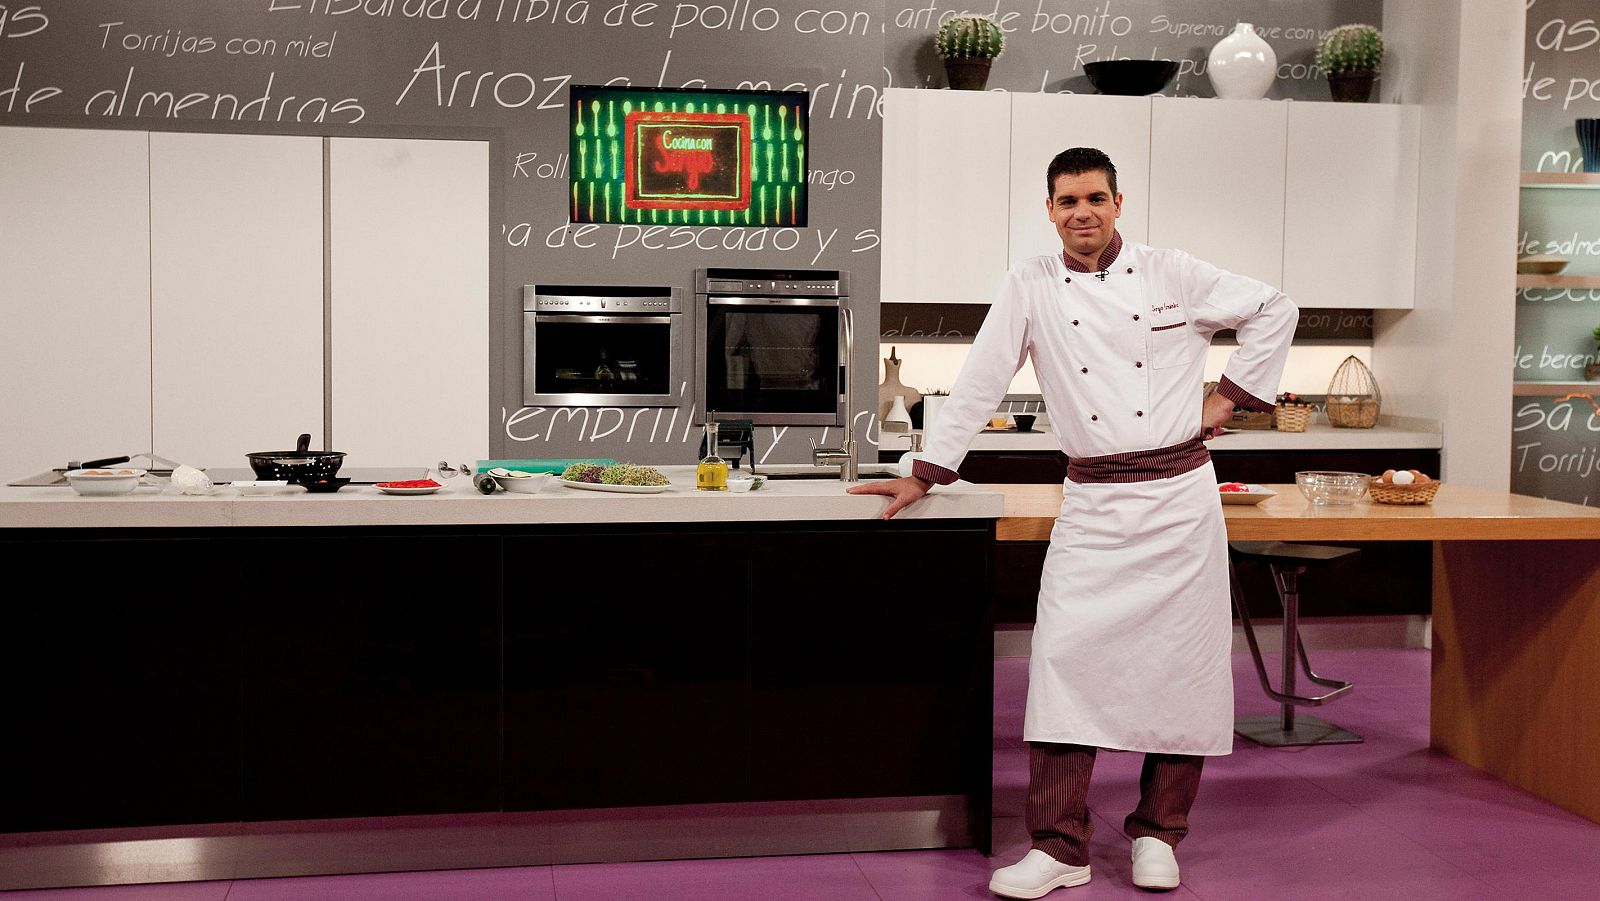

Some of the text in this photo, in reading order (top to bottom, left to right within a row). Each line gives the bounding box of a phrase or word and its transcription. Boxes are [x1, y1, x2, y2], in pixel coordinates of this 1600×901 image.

[0, 5, 49, 38] s
[267, 0, 483, 21] nsaada
[604, 0, 658, 27] de
[669, 0, 780, 39] pollo
[794, 10, 870, 35] con
[1031, 0, 1132, 37] bonito
[1149, 15, 1225, 39] Suprema
[1284, 28, 1314, 40] con
[99, 22, 337, 58] Torrijas con miel
[395, 41, 572, 110] Arroz
[85, 66, 366, 124] almendras
[502, 222, 531, 248] a
[545, 215, 601, 250] de
[611, 223, 801, 260] pescado
[810, 228, 838, 265] y
[502, 381, 705, 443] embrill
[760, 427, 789, 464] y
[1514, 402, 1573, 432] sa
